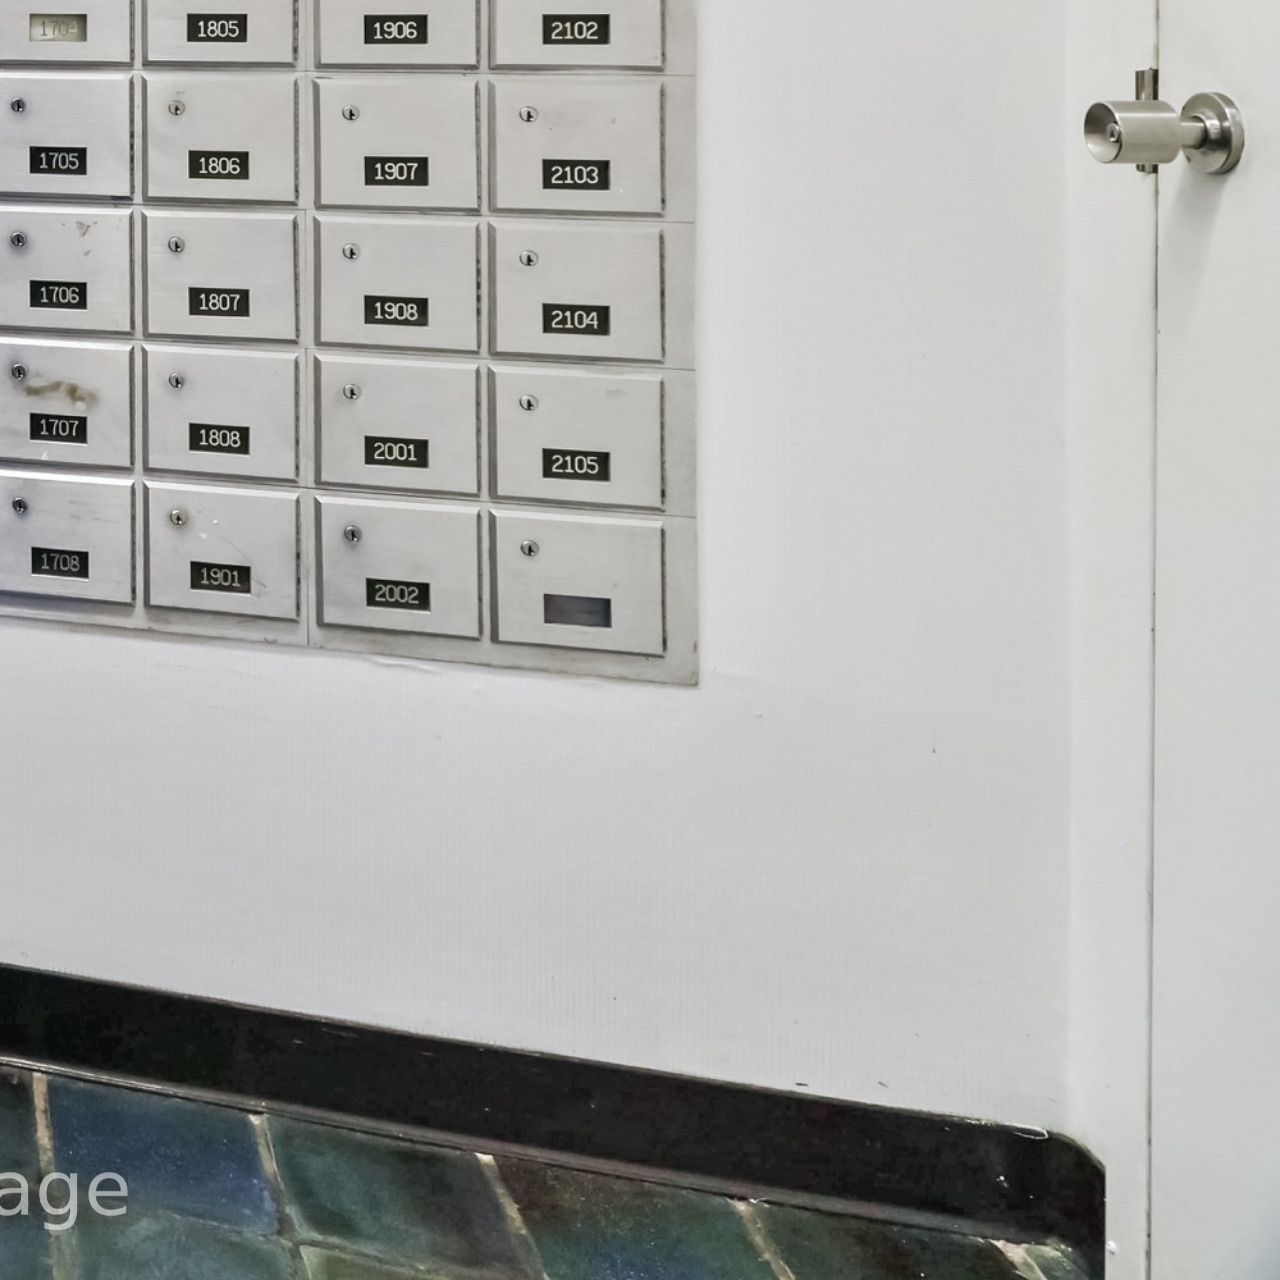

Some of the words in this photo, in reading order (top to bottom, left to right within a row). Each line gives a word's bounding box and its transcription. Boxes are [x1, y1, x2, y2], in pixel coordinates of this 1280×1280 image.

[198, 20, 239, 38] 1805
[374, 22, 417, 40] 1906
[552, 22, 598, 40] 2102
[40, 153, 78, 170] 1705
[200, 157, 240, 175] 1806
[375, 163, 418, 181] 1907
[552, 166, 598, 184] 2103
[41, 286, 79, 304] 1706
[200, 294, 240, 311] 1807
[375, 302, 418, 321] 1908
[552, 310, 598, 330] 2104
[41, 419, 78, 437] 1707
[200, 429, 240, 448] 1808
[374, 443, 416, 461] 2001
[552, 455, 598, 475] 2105
[42, 553, 80, 572] 1708
[201, 568, 240, 587] 1901
[375, 584, 419, 605] 2002
